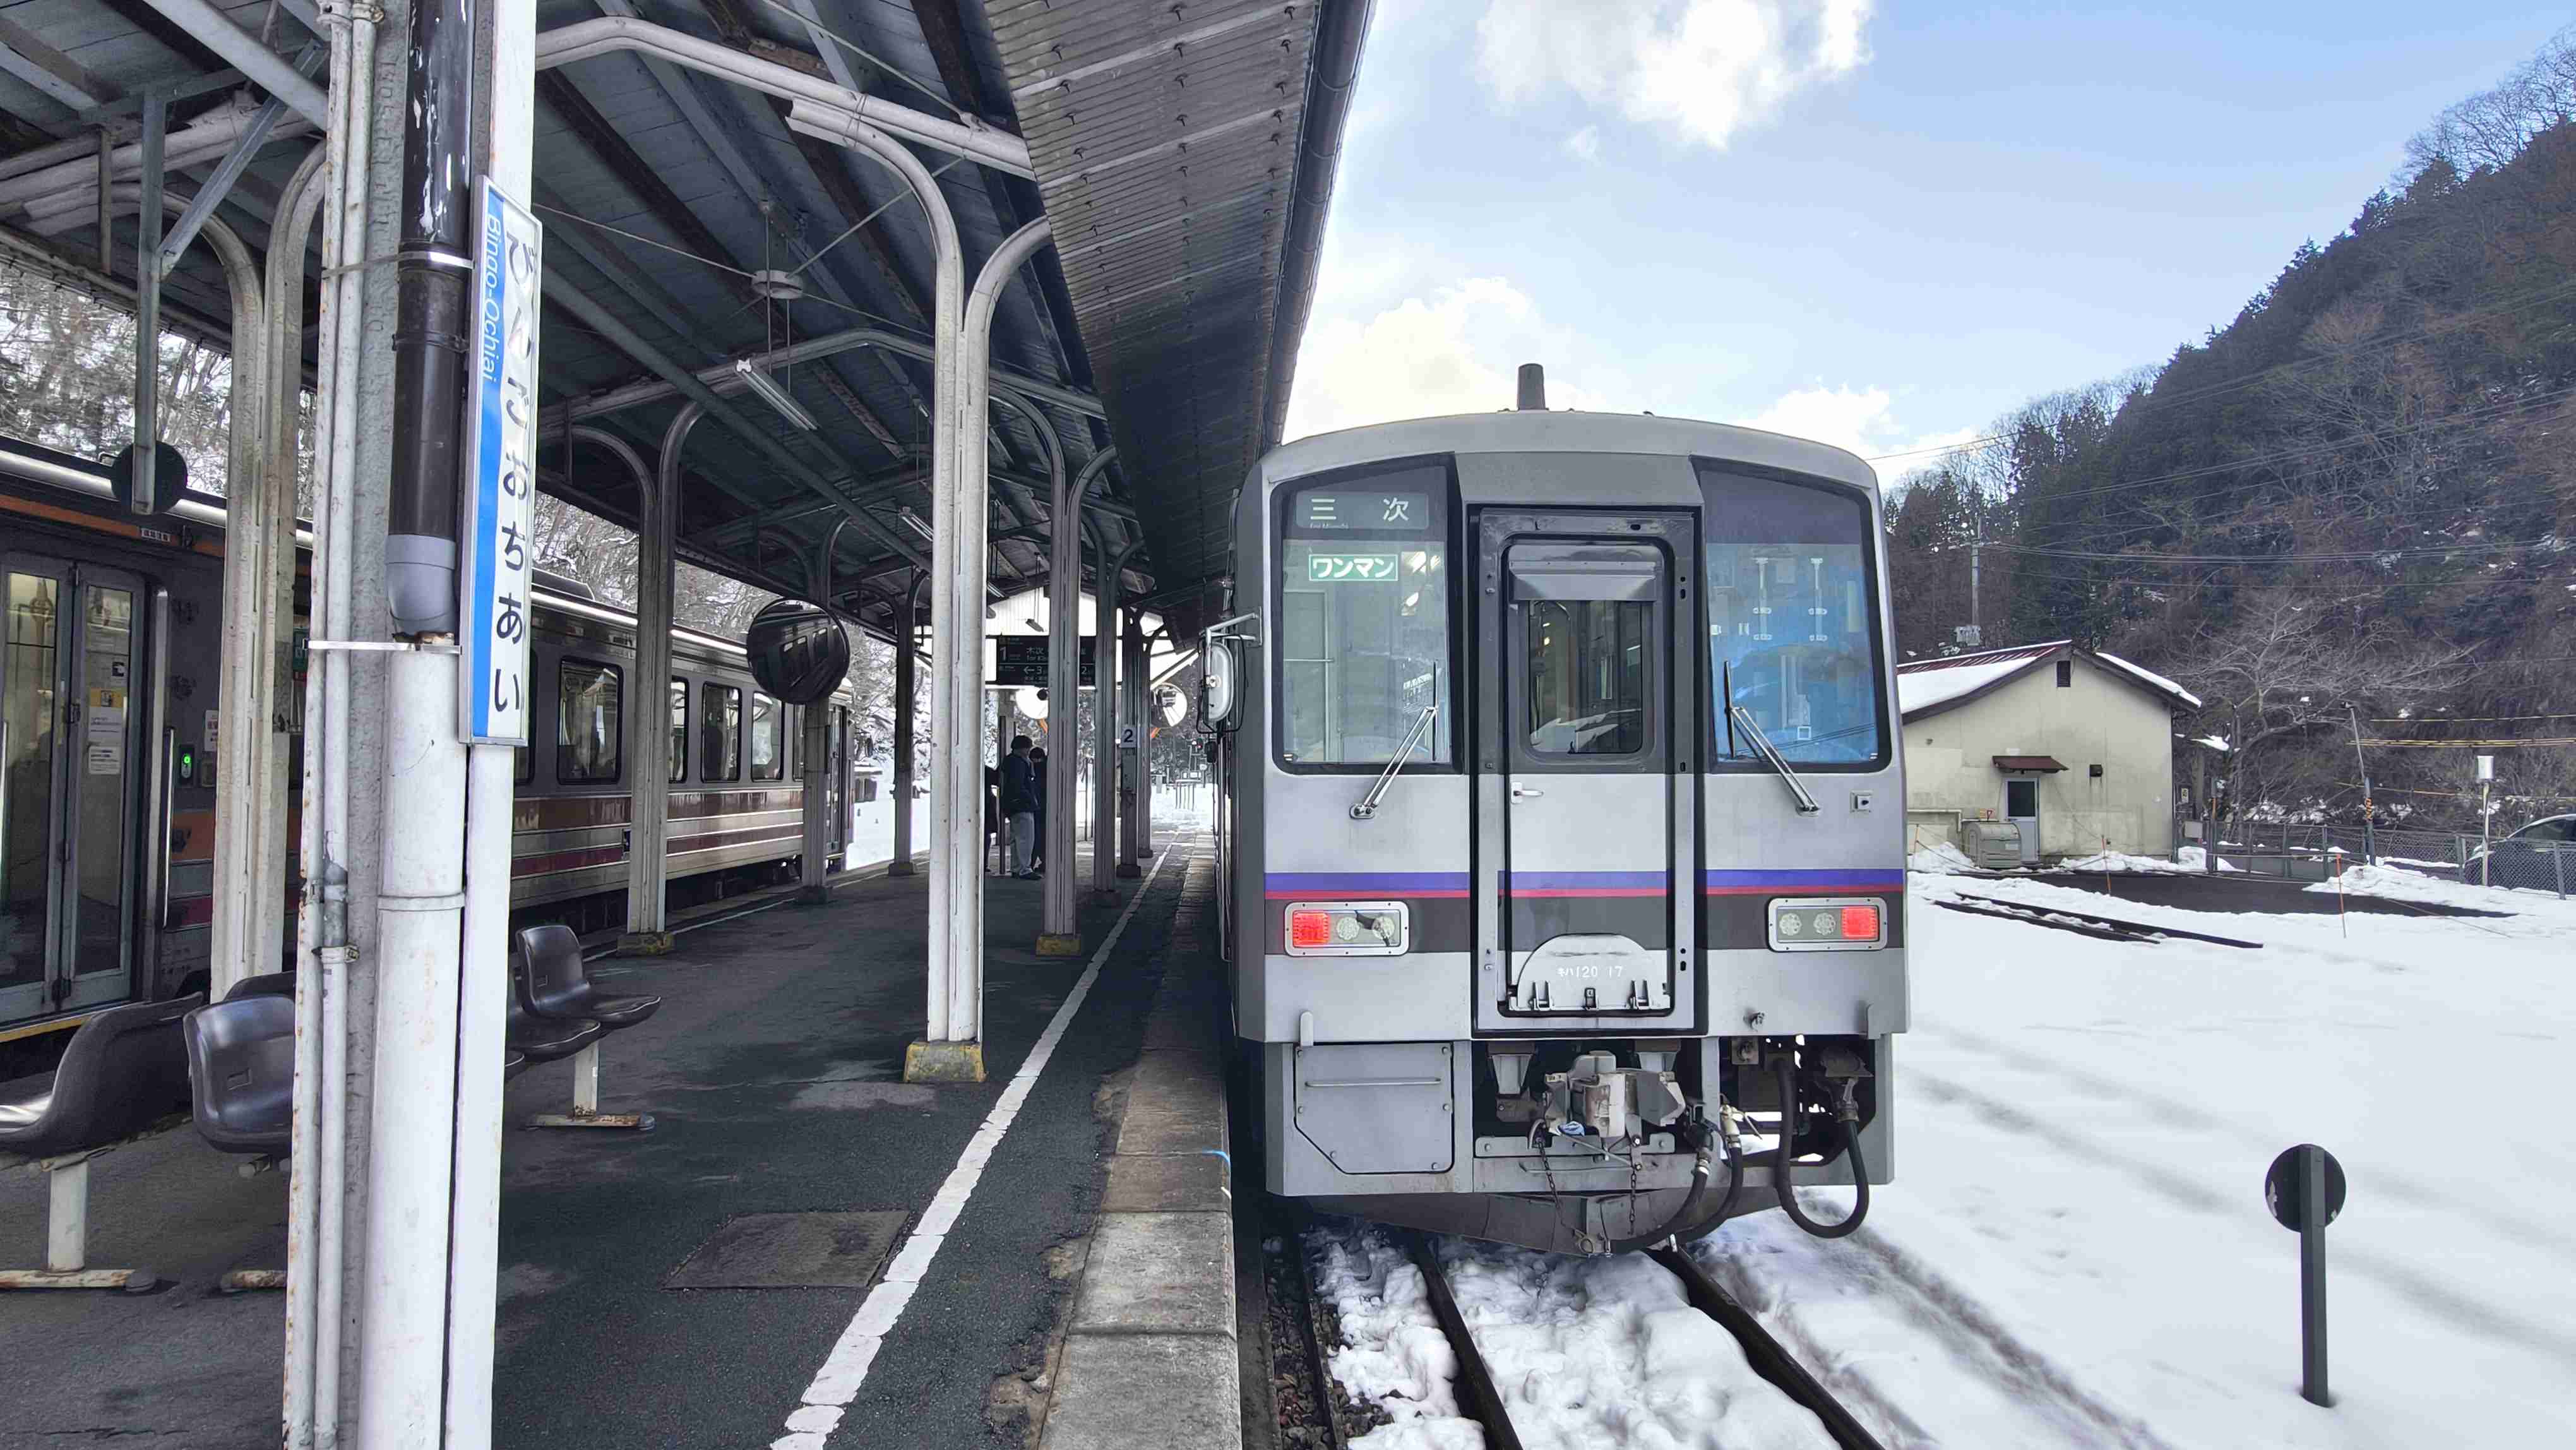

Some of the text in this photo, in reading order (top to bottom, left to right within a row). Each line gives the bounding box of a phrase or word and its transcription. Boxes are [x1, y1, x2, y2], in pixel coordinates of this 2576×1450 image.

[482, 214, 502, 382] Bingo-Ochiai
[494, 229, 535, 713] びんごおちあい
[1309, 497, 1410, 522] 三次
[1311, 557, 1394, 579] ワンマン
[1123, 728, 1134, 743] 2
[1556, 965, 1623, 978] キハ120 17
